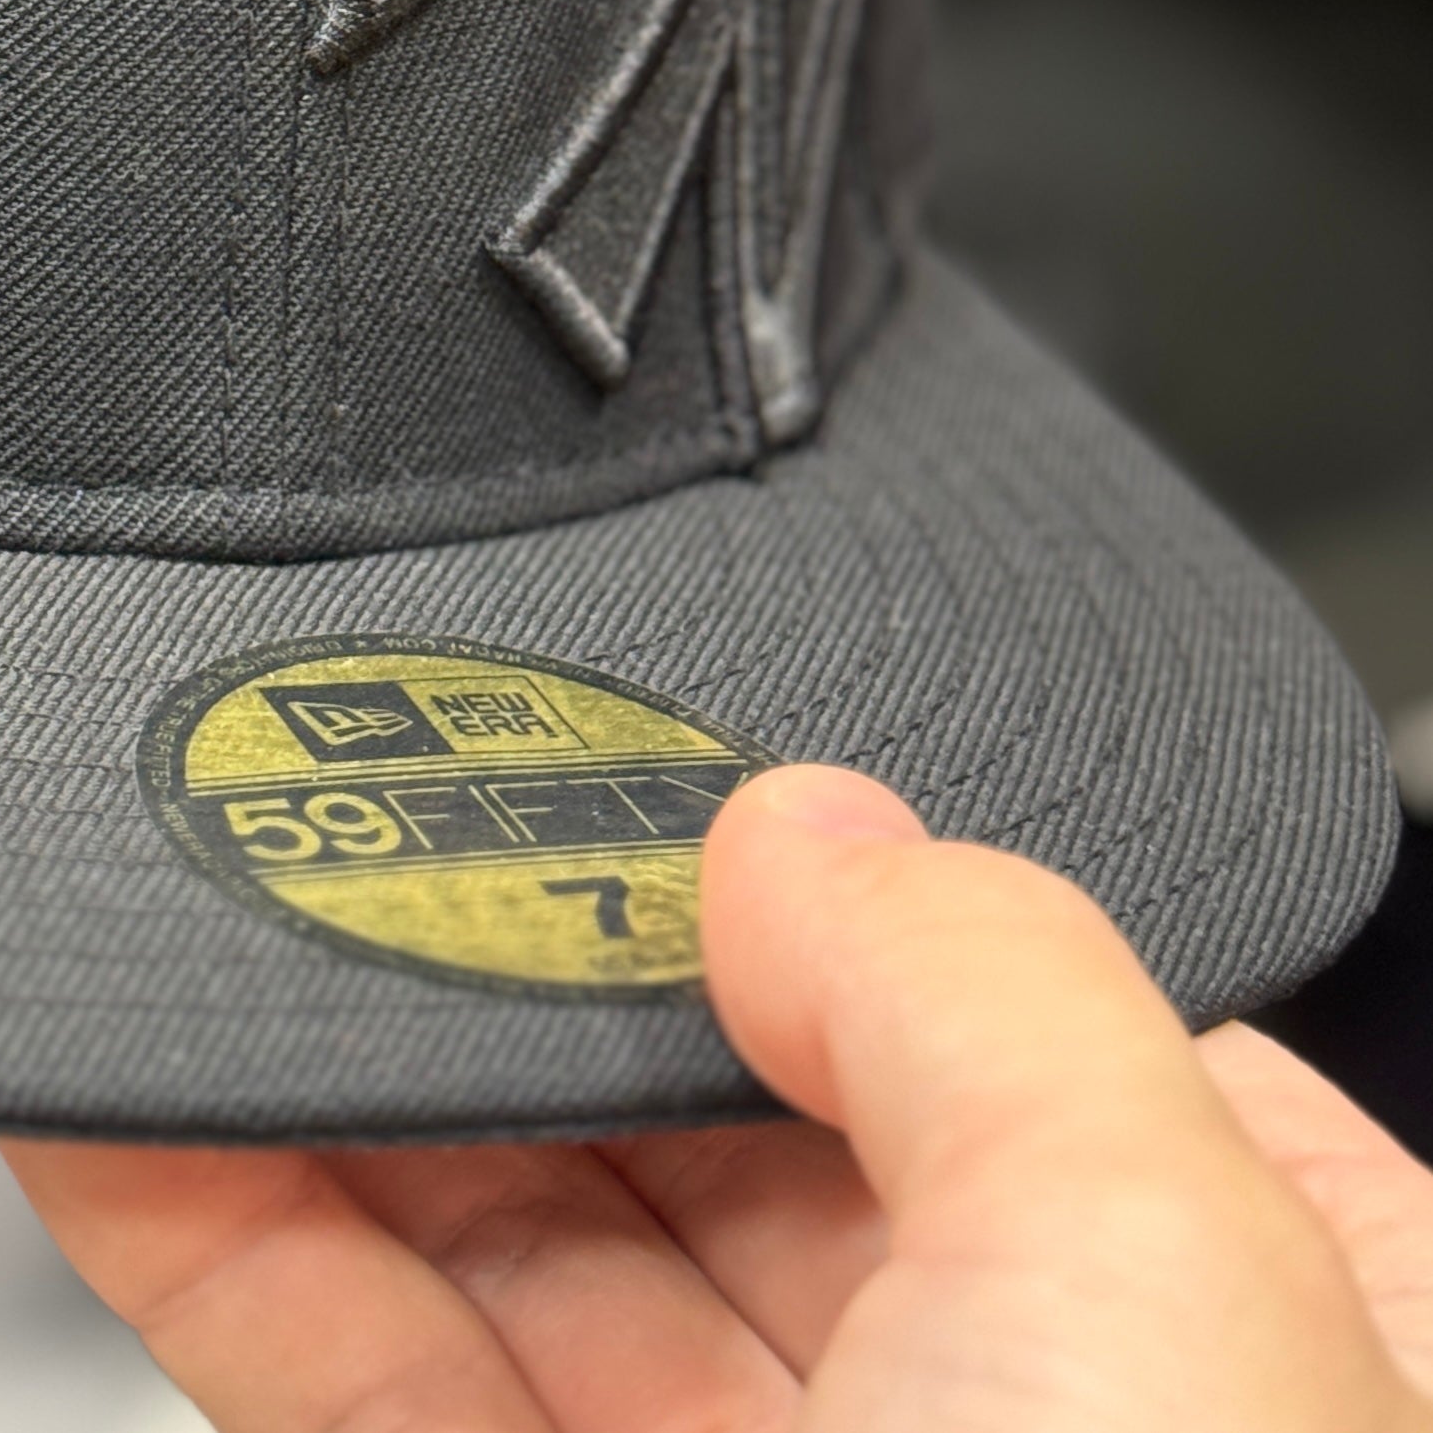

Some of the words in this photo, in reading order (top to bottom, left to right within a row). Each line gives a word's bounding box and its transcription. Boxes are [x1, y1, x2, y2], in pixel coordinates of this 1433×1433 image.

[429, 691, 535, 714] NEW
[449, 712, 560, 739] ERA
[537, 875, 636, 939] 7
